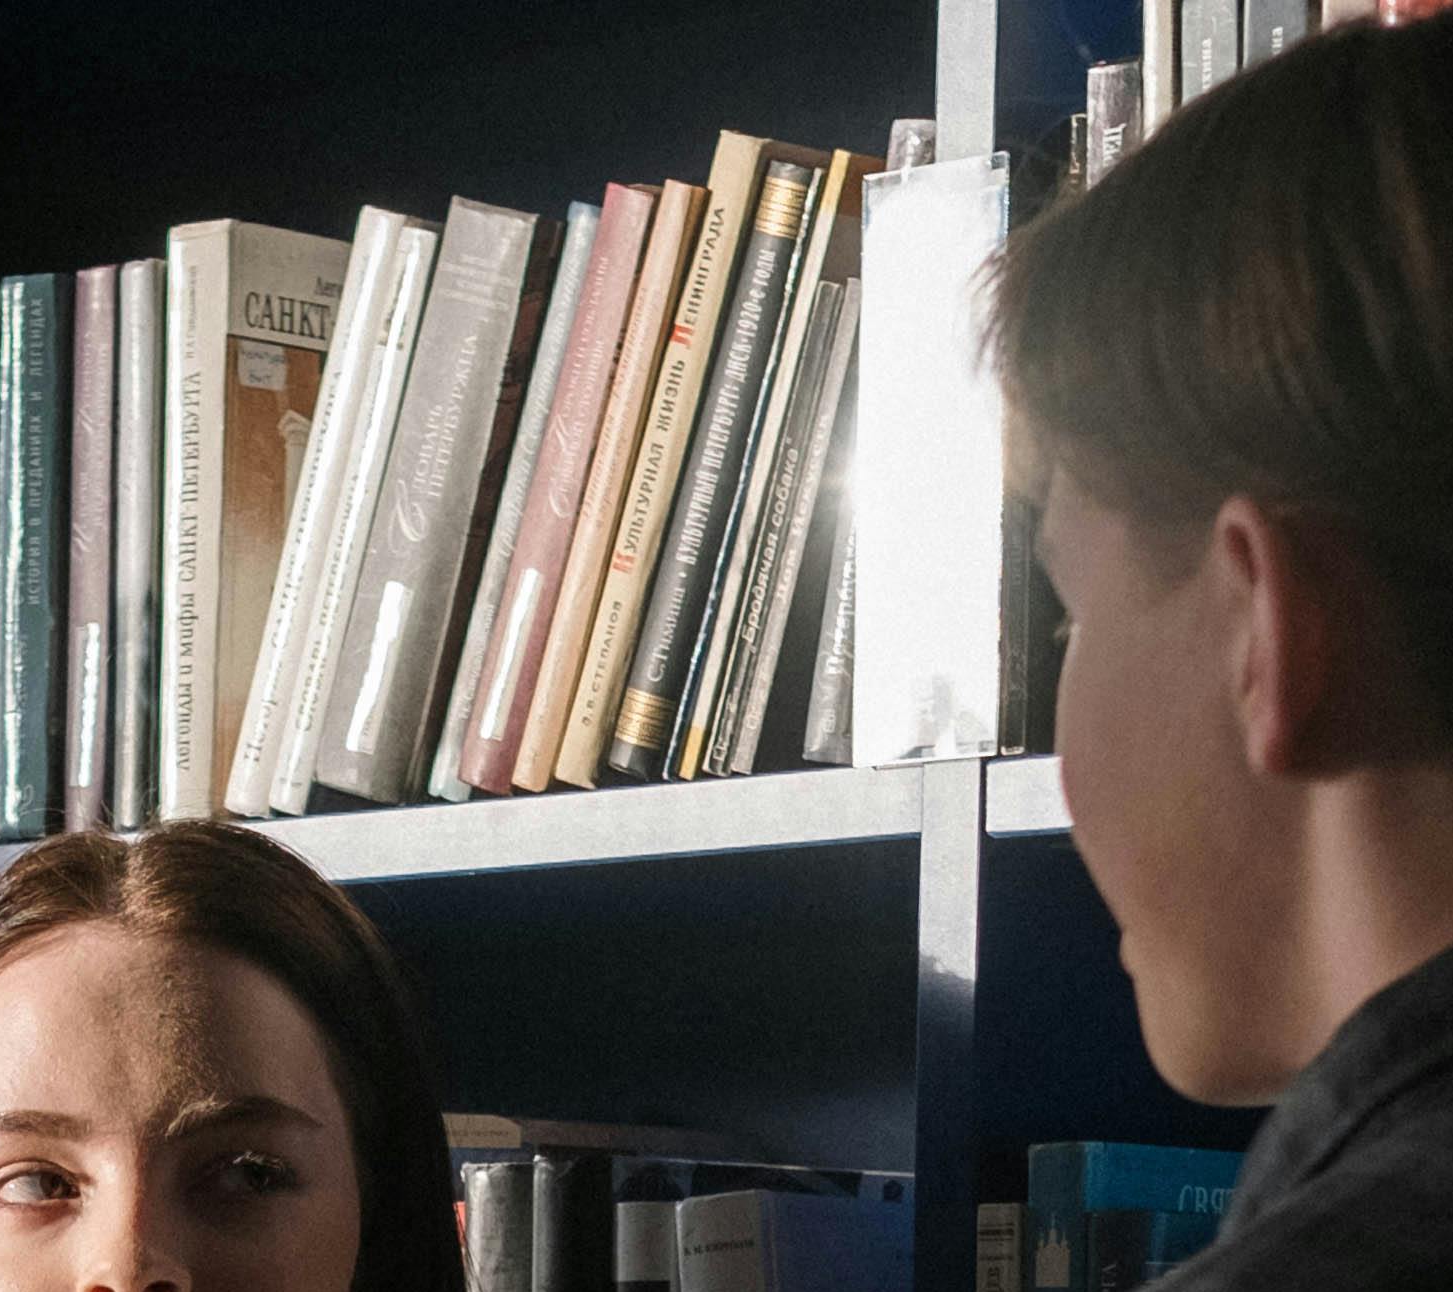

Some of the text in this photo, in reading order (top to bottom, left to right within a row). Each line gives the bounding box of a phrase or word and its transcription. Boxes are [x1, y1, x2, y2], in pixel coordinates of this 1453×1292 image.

[667, 204, 726, 352] ЛЕНИНГРАДА
[26, 296, 44, 606] ИСТОРИЯ В ПРЕДАНИЯХ И ЛЕГЕНДАХ
[653, 358, 686, 435] ЖИЗНЬ
[673, 467, 720, 567] КУЛЬТУРНЫЙ
[751, 248, 778, 287] годы
[613, 440, 667, 577] КУЛЬТУРНАЯ
